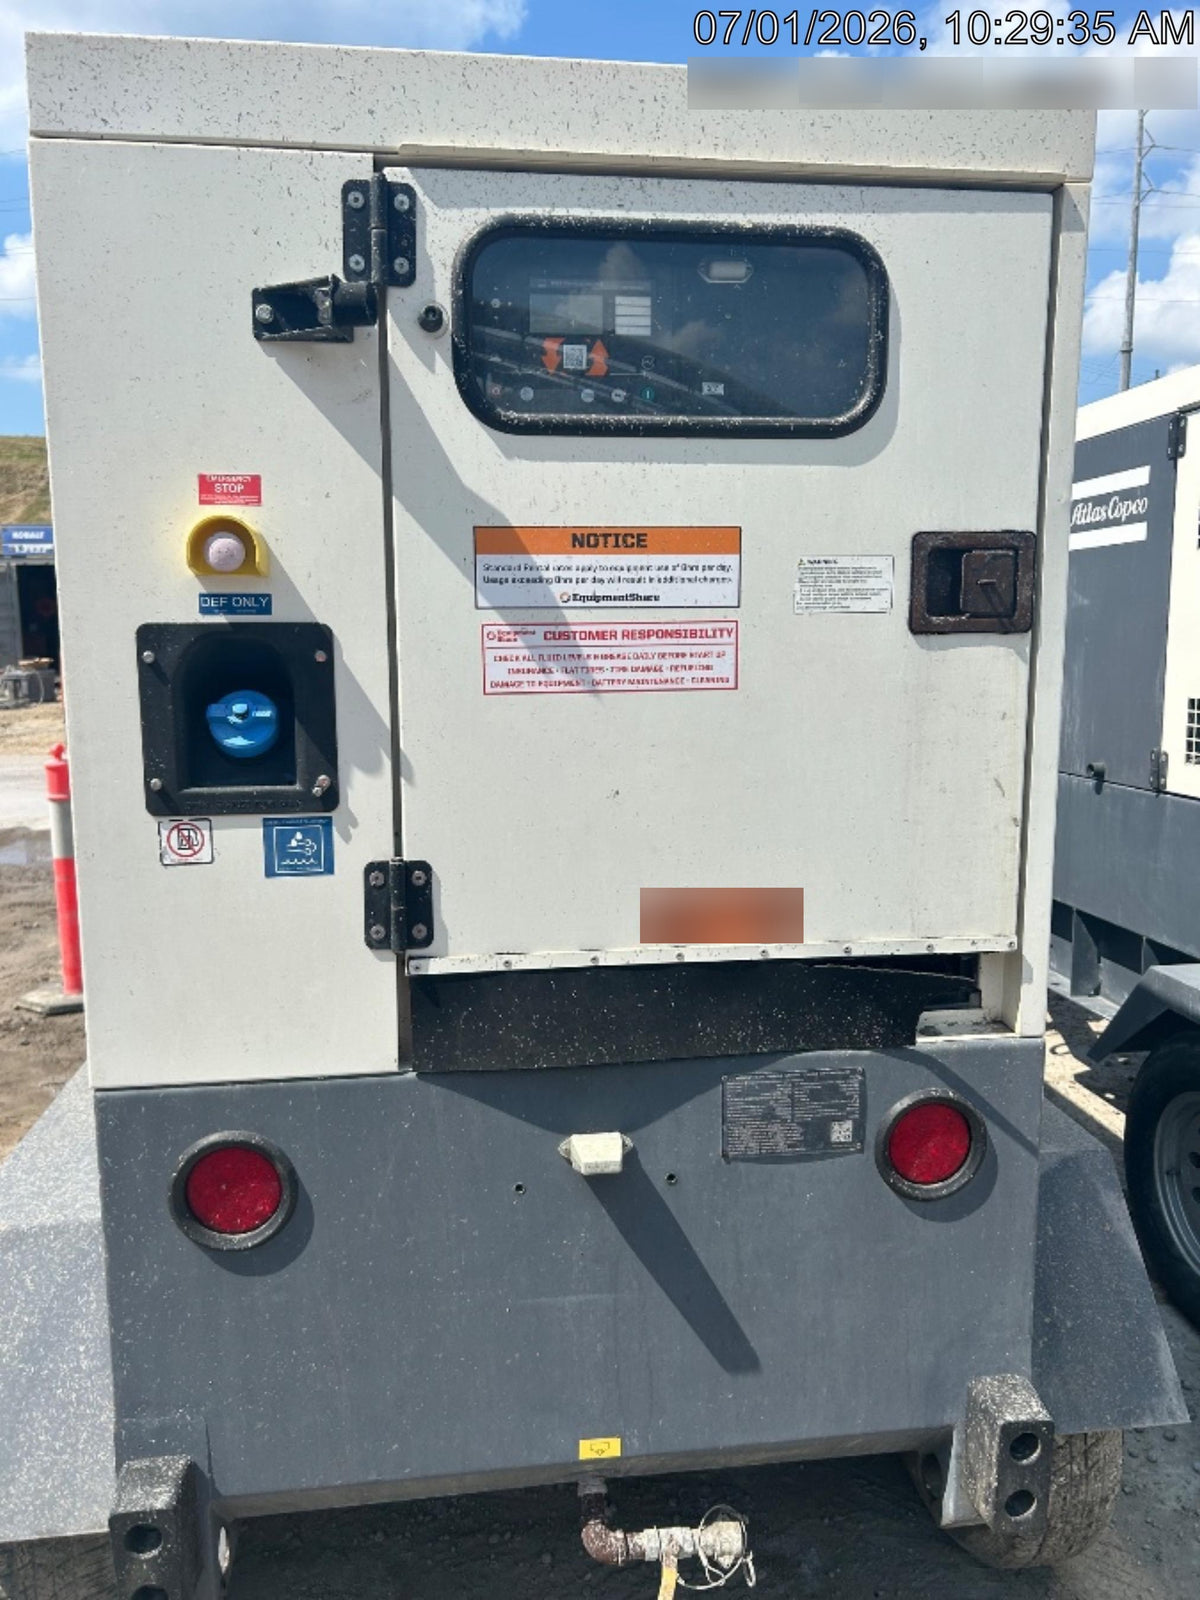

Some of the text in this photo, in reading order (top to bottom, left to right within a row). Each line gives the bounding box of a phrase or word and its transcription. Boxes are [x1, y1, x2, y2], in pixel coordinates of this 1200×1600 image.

[214, 483, 244, 493] STOP
[1070, 495, 1148, 527] Atlas Copco
[571, 533, 648, 548] NOTICE
[200, 597, 269, 607] DEF ONLY
[571, 592, 660, 603] EquipmentShare
[543, 628, 734, 641] CUSTOMER RESPONSIBILITY
